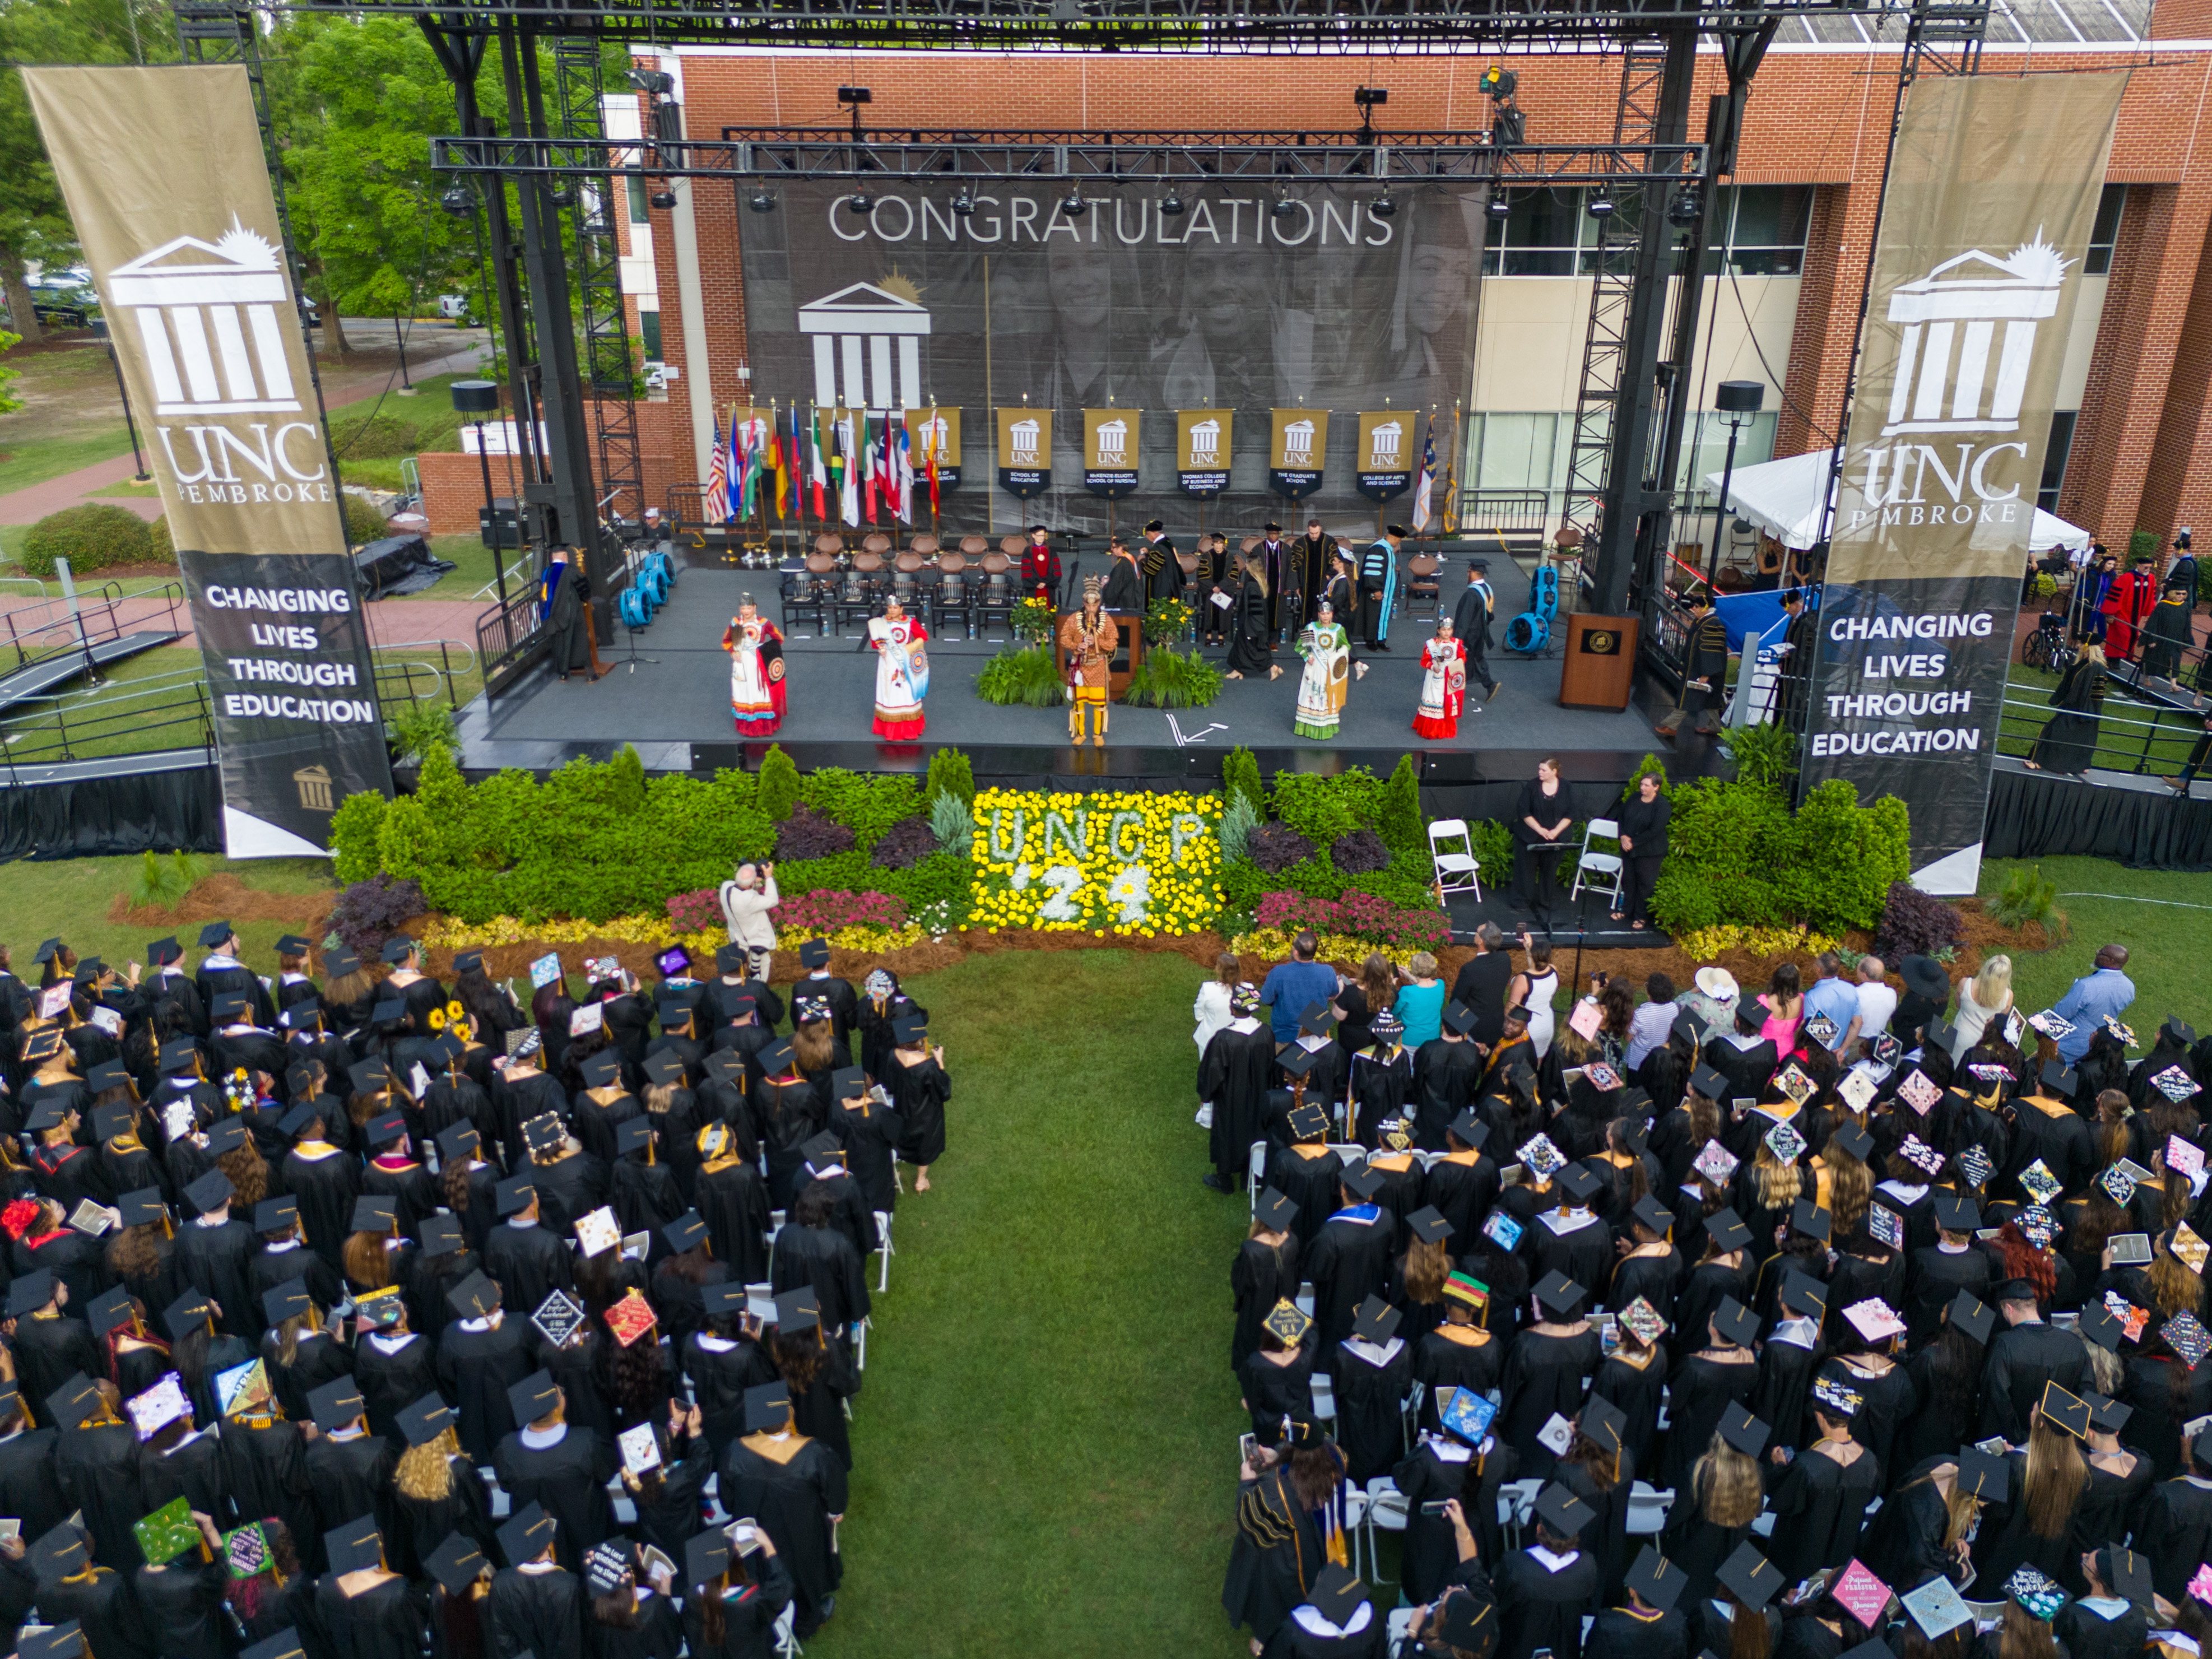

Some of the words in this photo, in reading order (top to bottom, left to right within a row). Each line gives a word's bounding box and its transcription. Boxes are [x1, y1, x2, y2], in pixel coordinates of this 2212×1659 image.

[829, 195, 1393, 245] CONGRATULATIONS
[157, 423, 324, 483] UNC
[1011, 452, 1039, 463] UNC
[1098, 453, 1126, 463] UNC
[1190, 453, 1219, 464] UNC
[1284, 452, 1313, 464] UNC
[1371, 455, 1400, 465] UNC
[1864, 443, 2027, 508] UNC
[176, 483, 331, 504] PEMBROKE
[207, 585, 351, 612] CHANGING
[252, 624, 318, 649] LIVES
[1830, 614, 1992, 641] CHANGING
[228, 658, 356, 686] THROUGH
[1864, 654, 1946, 677] LIVES
[225, 694, 373, 722] EDUCATION
[1827, 691, 1971, 717] THROUGH
[1811, 728, 1979, 756] EDUCATION
[357, 1293, 375, 1302] CRIME
[234, 1372, 250, 1395] 1906
[231, 1541, 245, 1551] BEST
